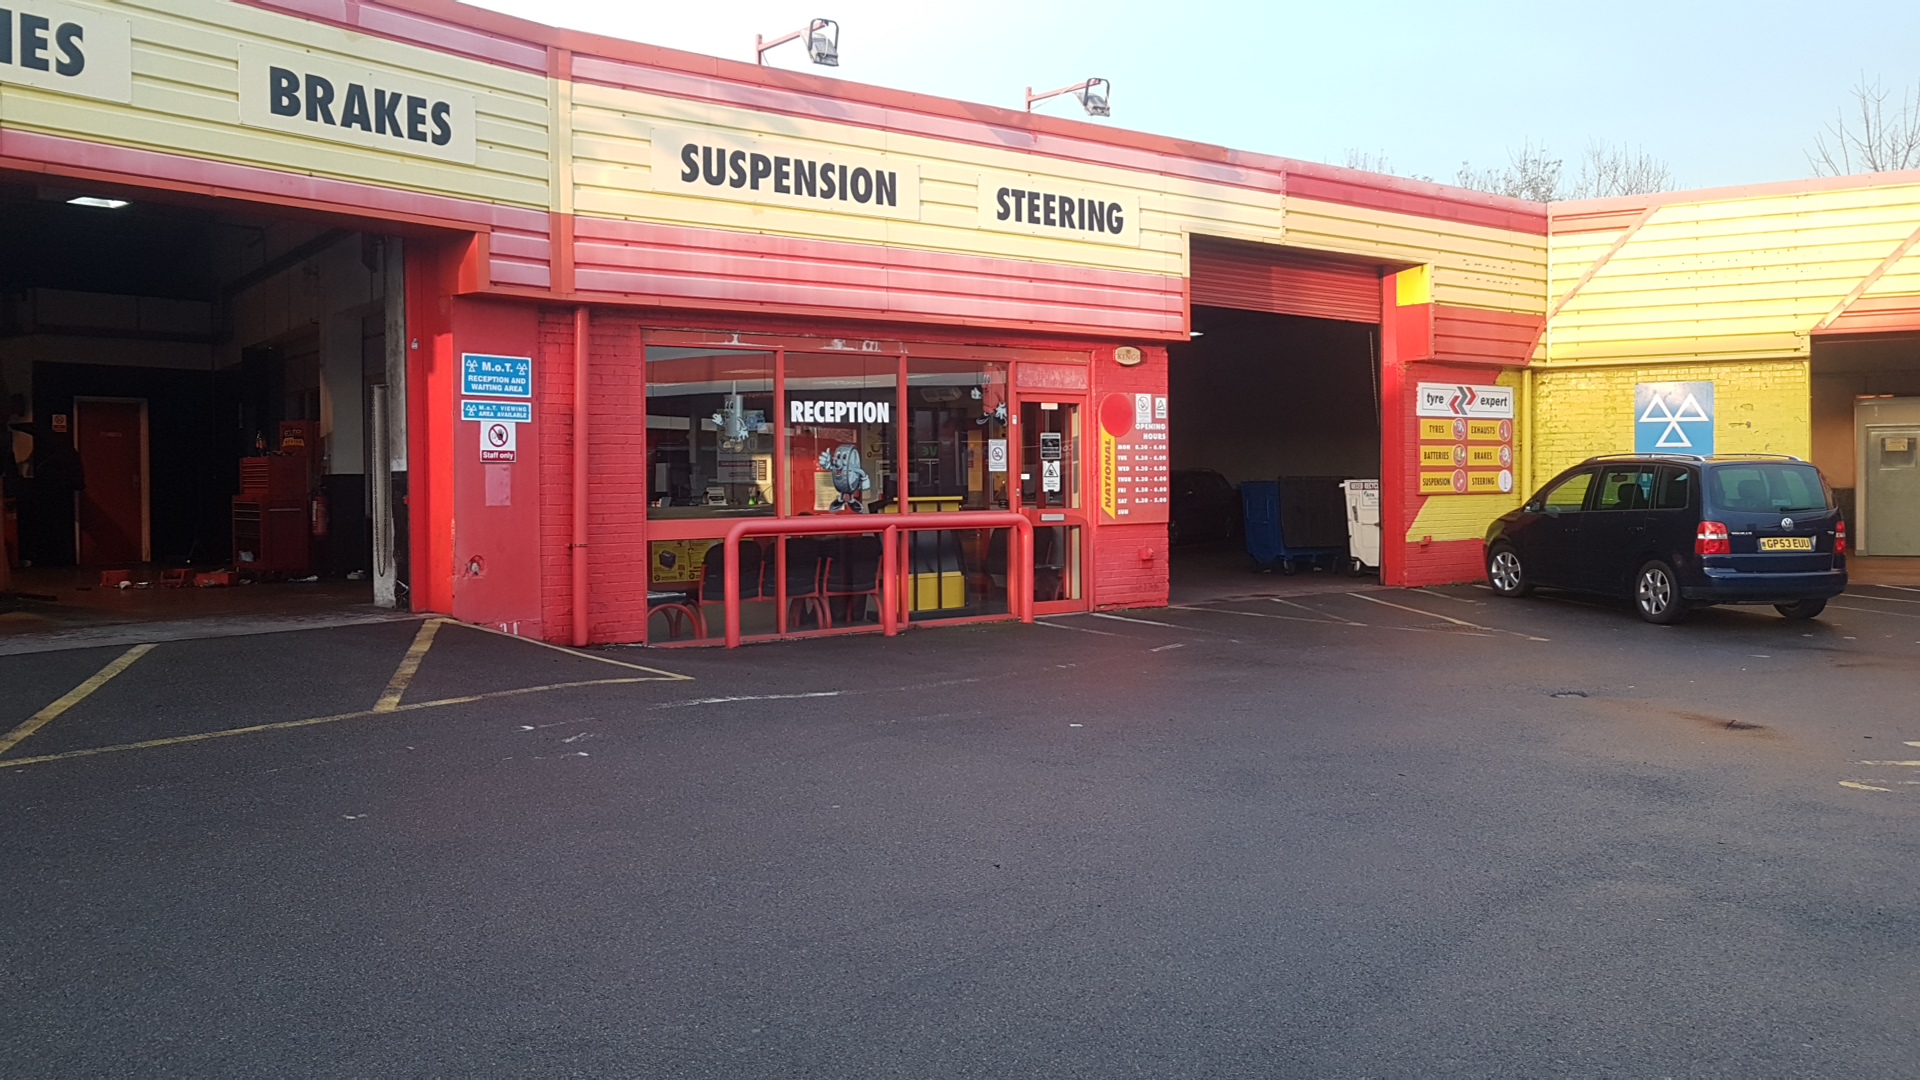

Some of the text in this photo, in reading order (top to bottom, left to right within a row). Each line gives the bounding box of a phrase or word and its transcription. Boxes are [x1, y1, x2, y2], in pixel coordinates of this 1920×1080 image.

[270, 66, 452, 146] BRAKES
[680, 143, 897, 207] SUSPENSION
[996, 187, 1124, 235] STEERING
[482, 362, 513, 372] M.o.T.
[468, 375, 510, 384] RECEPTION
[1427, 392, 1508, 408] tyre expert
[790, 400, 890, 422] RECEPTION
[1429, 425, 1444, 434] TYRES
[1471, 426, 1495, 434] EXHAUSTS
[500, 452, 514, 460] only
[1424, 452, 1449, 460] BATTERIES
[1423, 478, 1450, 486] SUSPENSION
[1766, 539, 1810, 548] GP53 EUU
